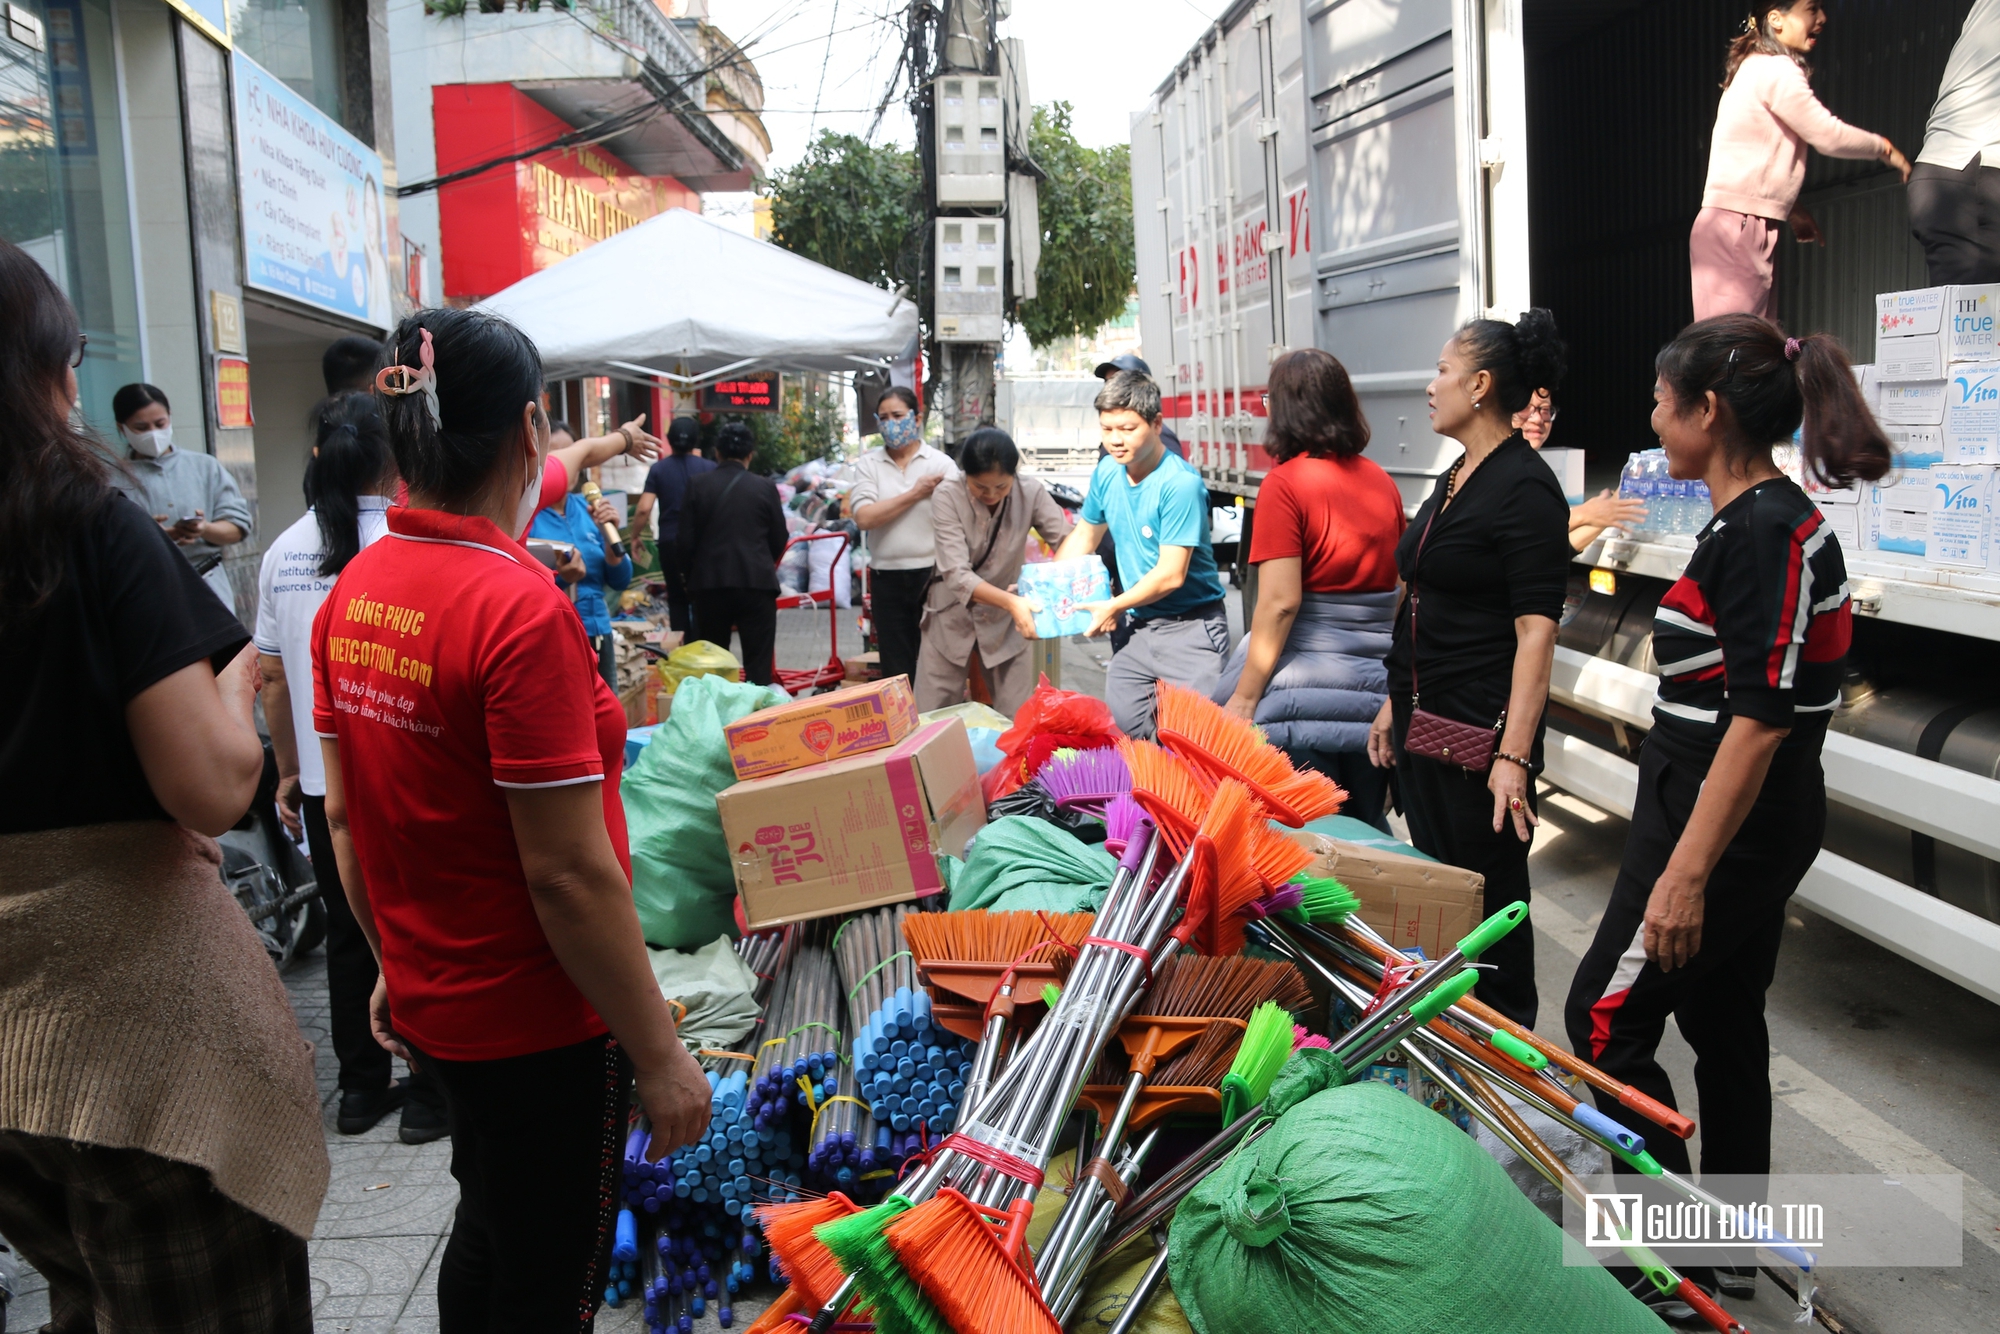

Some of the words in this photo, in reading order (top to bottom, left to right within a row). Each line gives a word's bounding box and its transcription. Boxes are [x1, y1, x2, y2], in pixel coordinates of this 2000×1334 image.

[266, 95, 290, 132] NHA
[290, 112, 318, 151] KHOA
[259, 137, 274, 160] Nha
[275, 147, 293, 171] Khoa
[532, 161, 602, 242] THANH
[1235, 260, 1267, 289] OGISTICS
[1882, 299, 1893, 308] TH
[1898, 295, 1915, 306] true
[1915, 293, 1939, 304] WATER
[1956, 299, 1977, 313] TH
[222, 305, 235, 332] 12
[1954, 314, 1993, 333] true
[1954, 333, 1993, 346] WATER
[1889, 389, 1899, 398] TH
[1904, 388, 1920, 398] true
[1954, 374, 1998, 404] Vita
[1935, 483, 1978, 510] Vita
[284, 551, 326, 561] Vietnam
[278, 566, 316, 577] Institute
[273, 583, 312, 593] esources
[384, 604, 425, 639] PHỤC
[350, 680, 365, 698] bộ
[397, 694, 415, 714] đẹp
[788, 822, 811, 833] GOLD
[790, 831, 824, 866] JU
[767, 844, 804, 886] JIN
[1406, 920, 1417, 938] PCS
